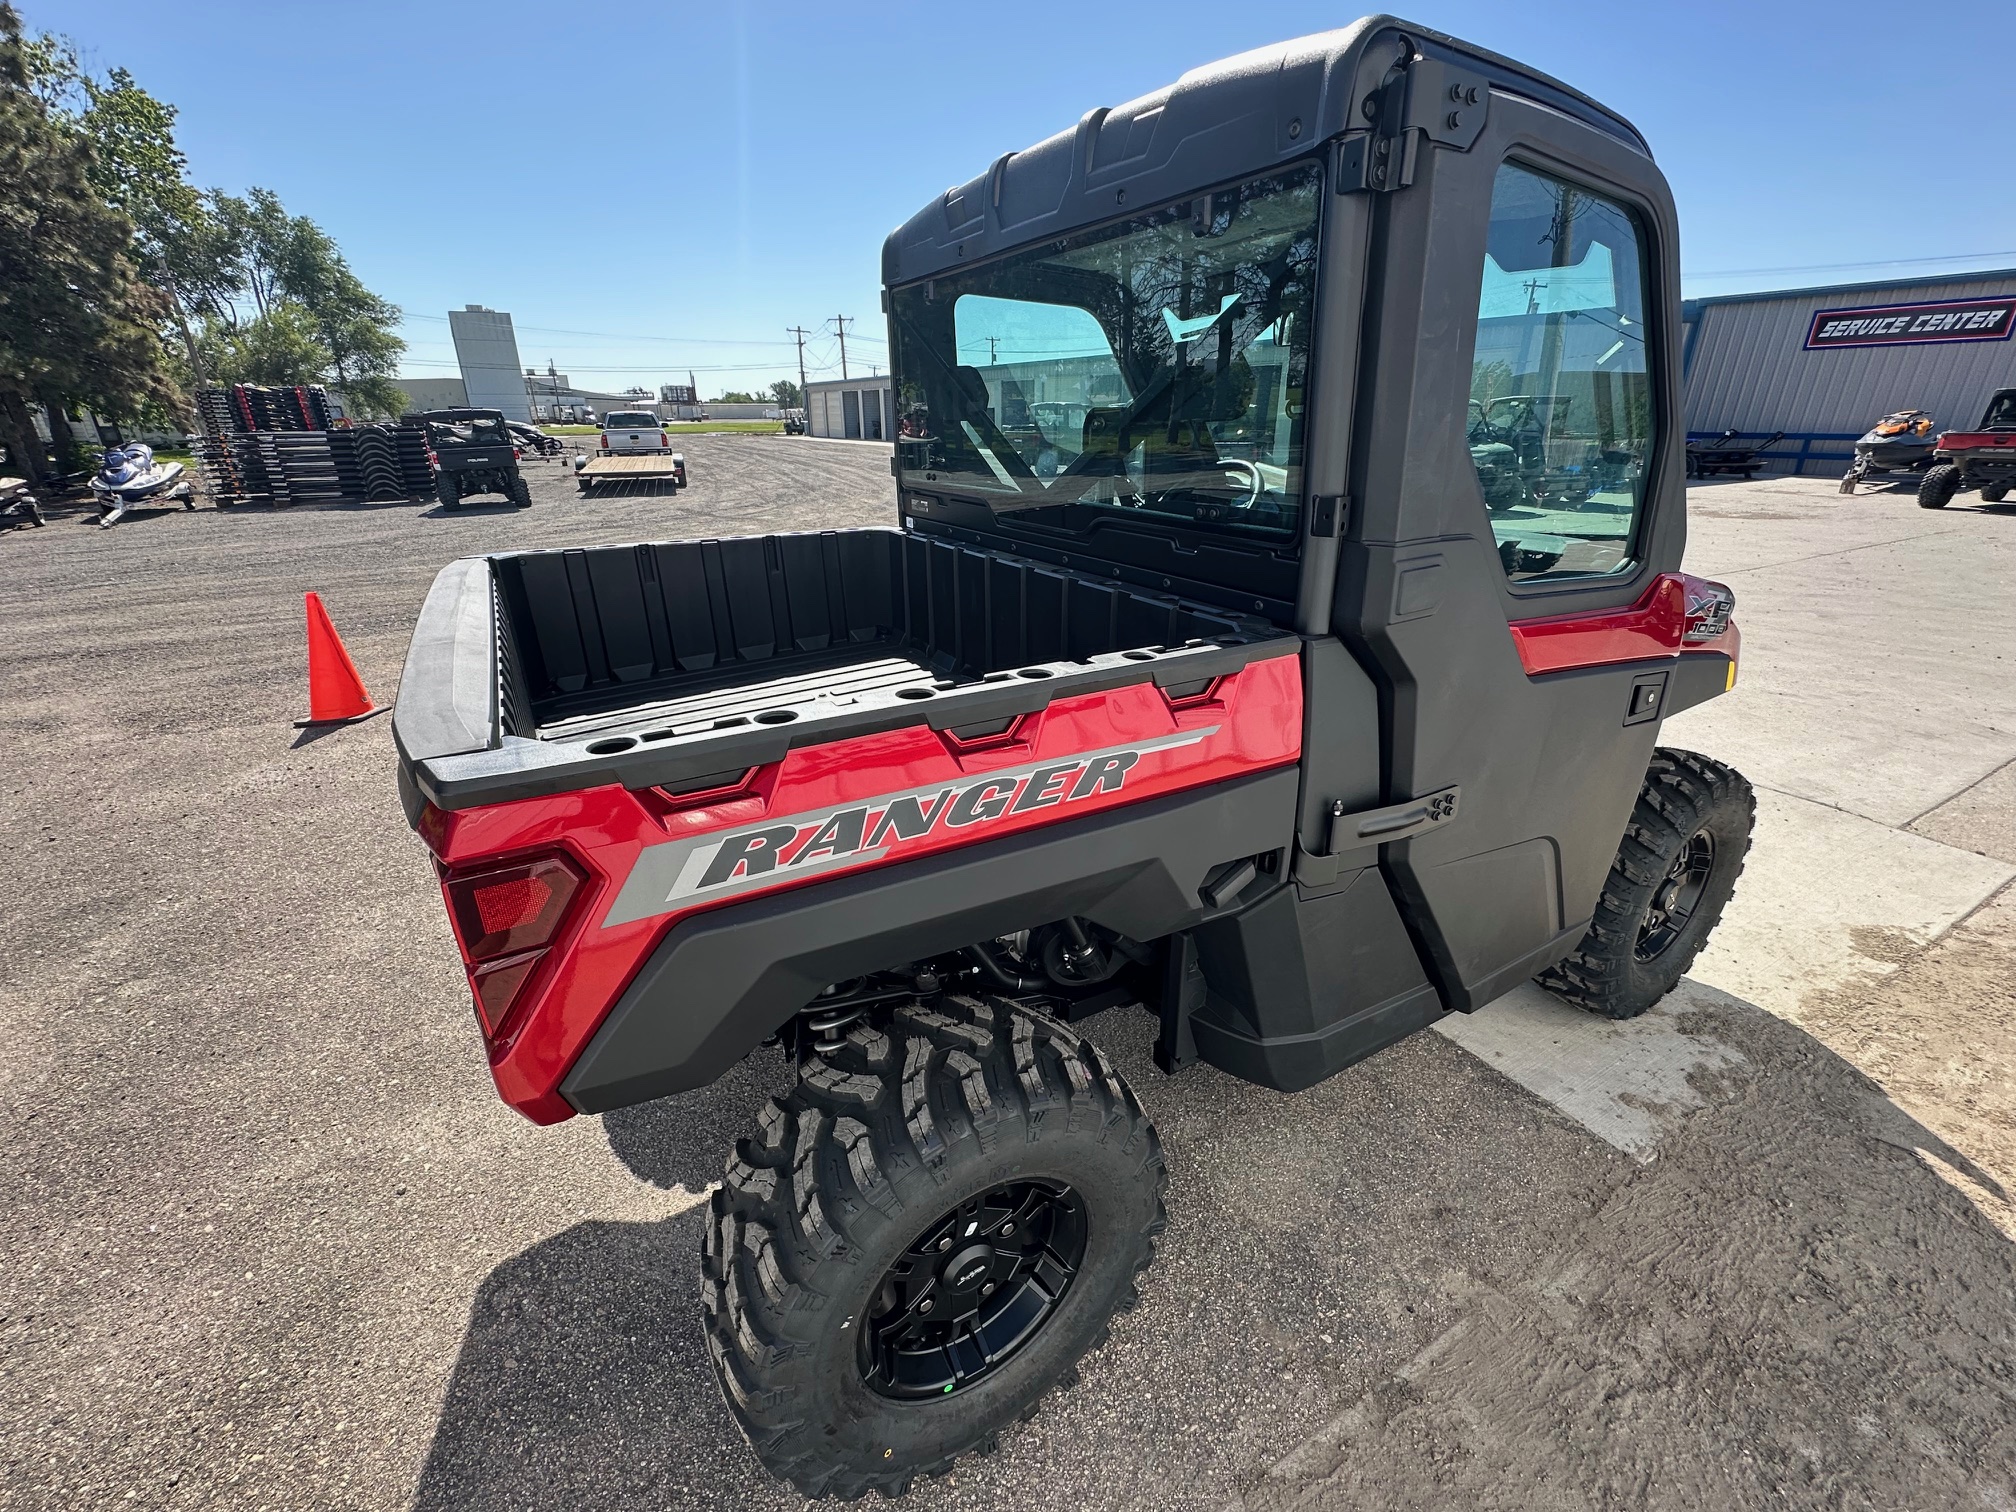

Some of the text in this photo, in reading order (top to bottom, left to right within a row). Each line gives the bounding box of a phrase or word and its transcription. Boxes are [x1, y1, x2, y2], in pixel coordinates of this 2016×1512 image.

[1818, 309, 2006, 337] SERVICE CENTER
[1685, 595, 1731, 618] XP
[695, 750, 1139, 889] RANGER
